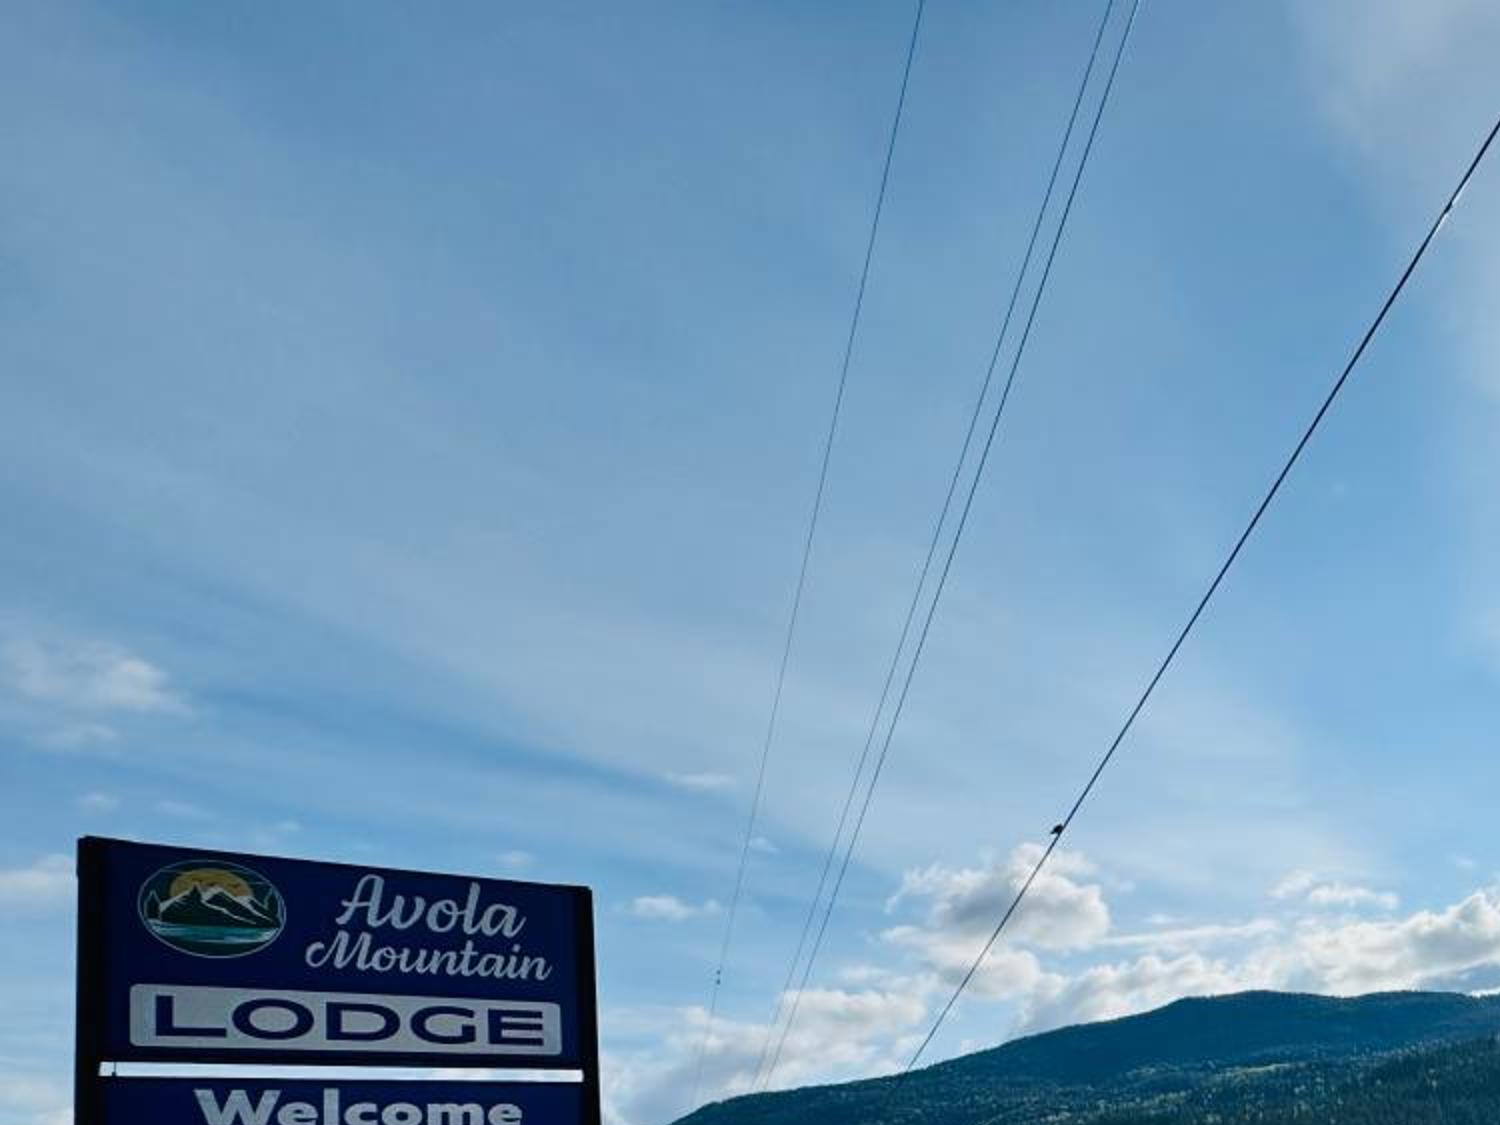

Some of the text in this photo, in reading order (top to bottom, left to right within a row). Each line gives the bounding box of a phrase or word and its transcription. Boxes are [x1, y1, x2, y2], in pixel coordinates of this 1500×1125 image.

[335, 874, 526, 937] Avola
[305, 930, 551, 980] Mountain
[155, 995, 544, 1047] LODGE
